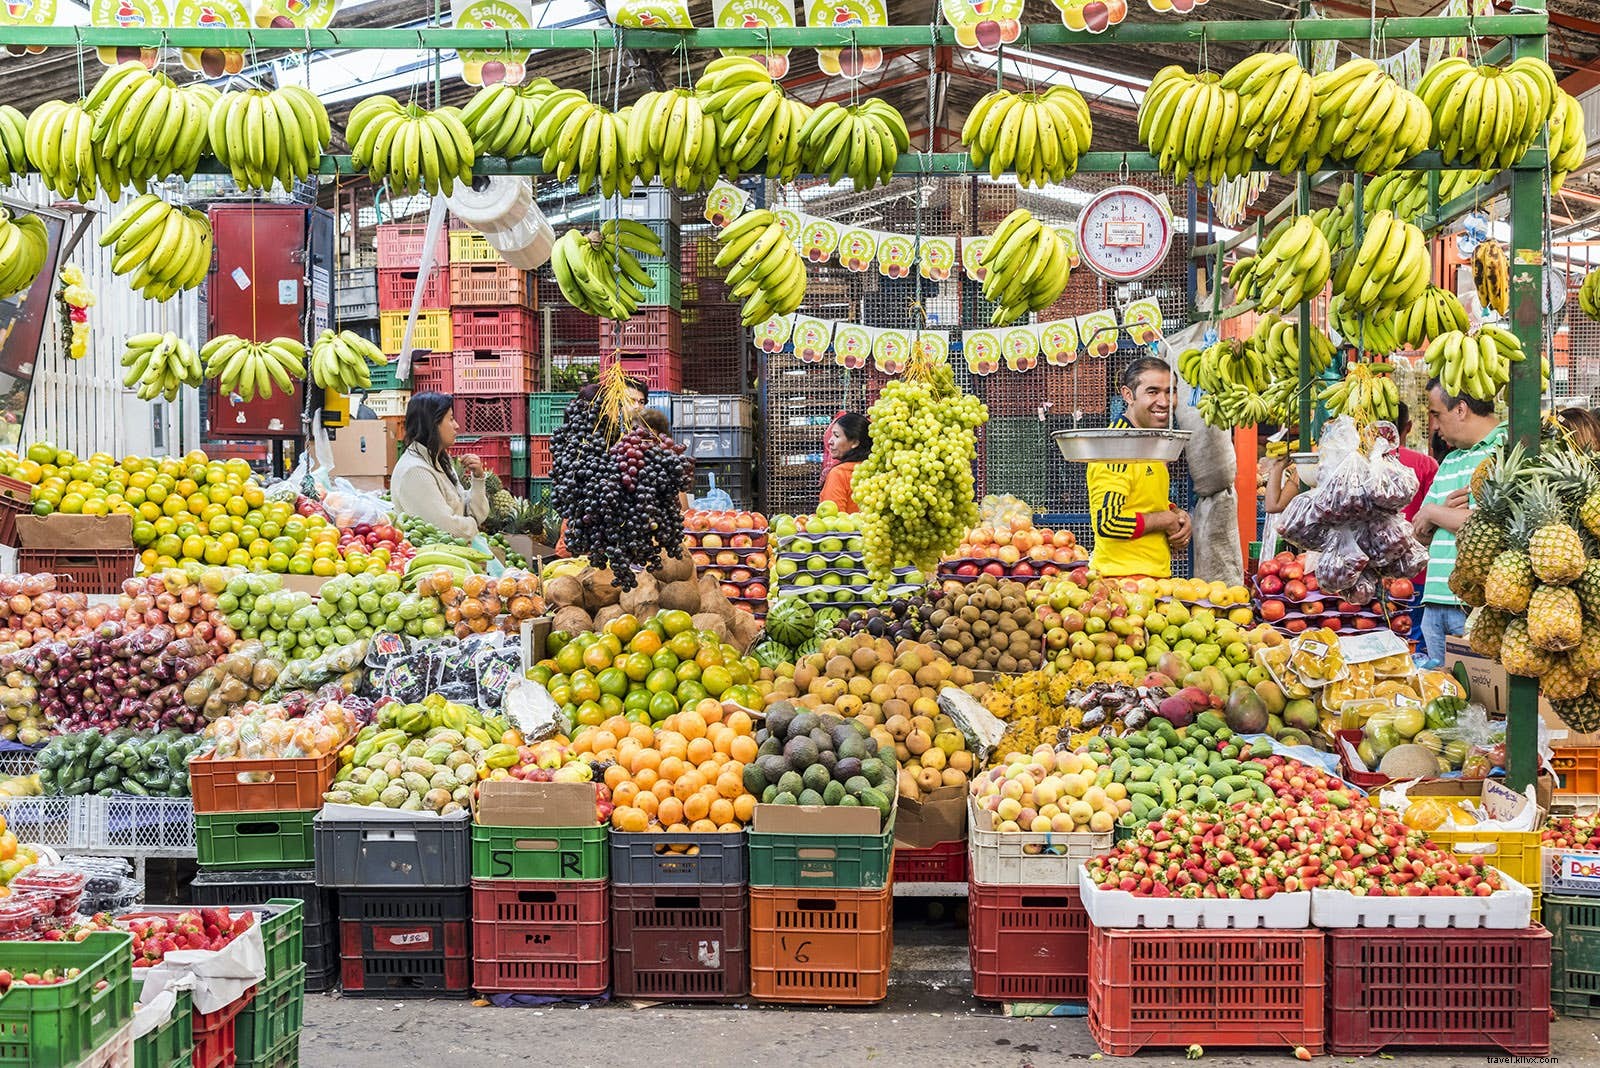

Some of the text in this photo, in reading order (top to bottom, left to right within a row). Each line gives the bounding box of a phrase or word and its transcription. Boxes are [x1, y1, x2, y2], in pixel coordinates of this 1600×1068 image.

[493, 852, 582, 877] S R
[525, 934, 551, 945] P&P
